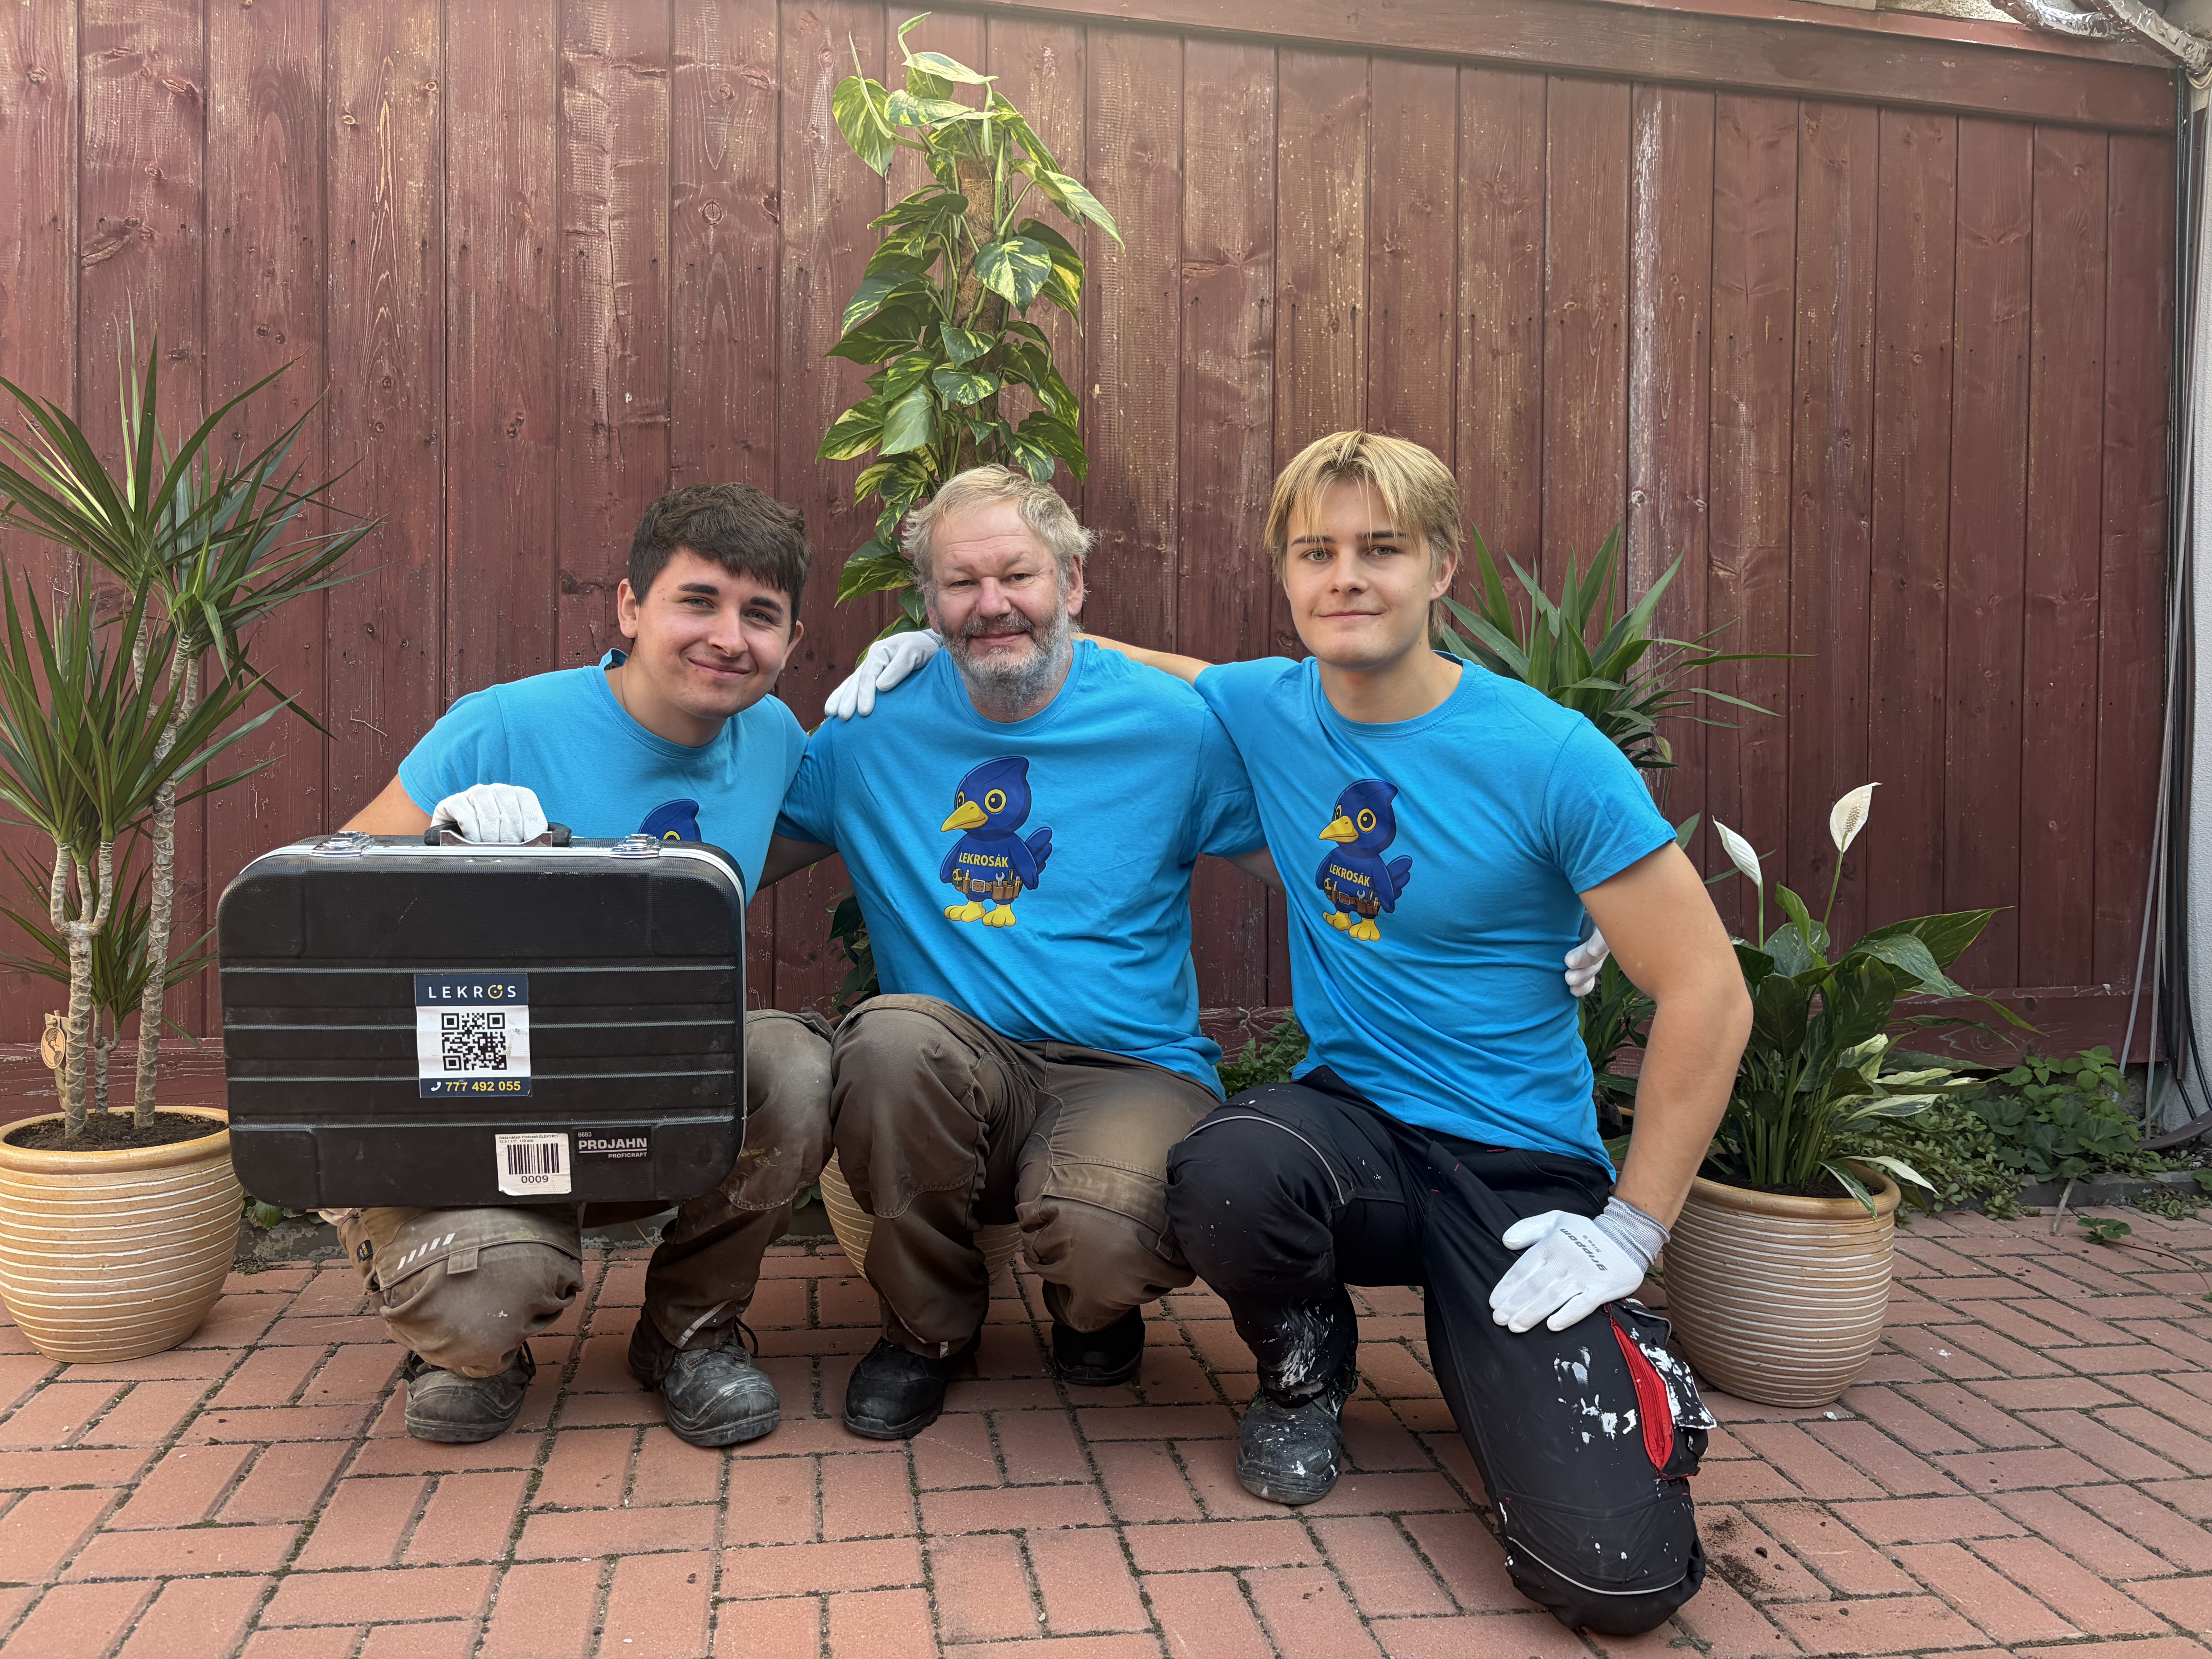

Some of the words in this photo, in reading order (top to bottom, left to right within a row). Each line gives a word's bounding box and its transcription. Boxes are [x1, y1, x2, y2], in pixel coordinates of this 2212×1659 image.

[958, 852, 1009, 868] LEKROSÁK
[1329, 863, 1370, 888] LEKROSÁK
[428, 985, 516, 999] LEKROS
[445, 1082, 467, 1092] 777
[472, 1081, 495, 1091] 492
[498, 1081, 521, 1091] 055
[579, 1138, 647, 1150] PROJAHN
[521, 1175, 548, 1183] 0009
